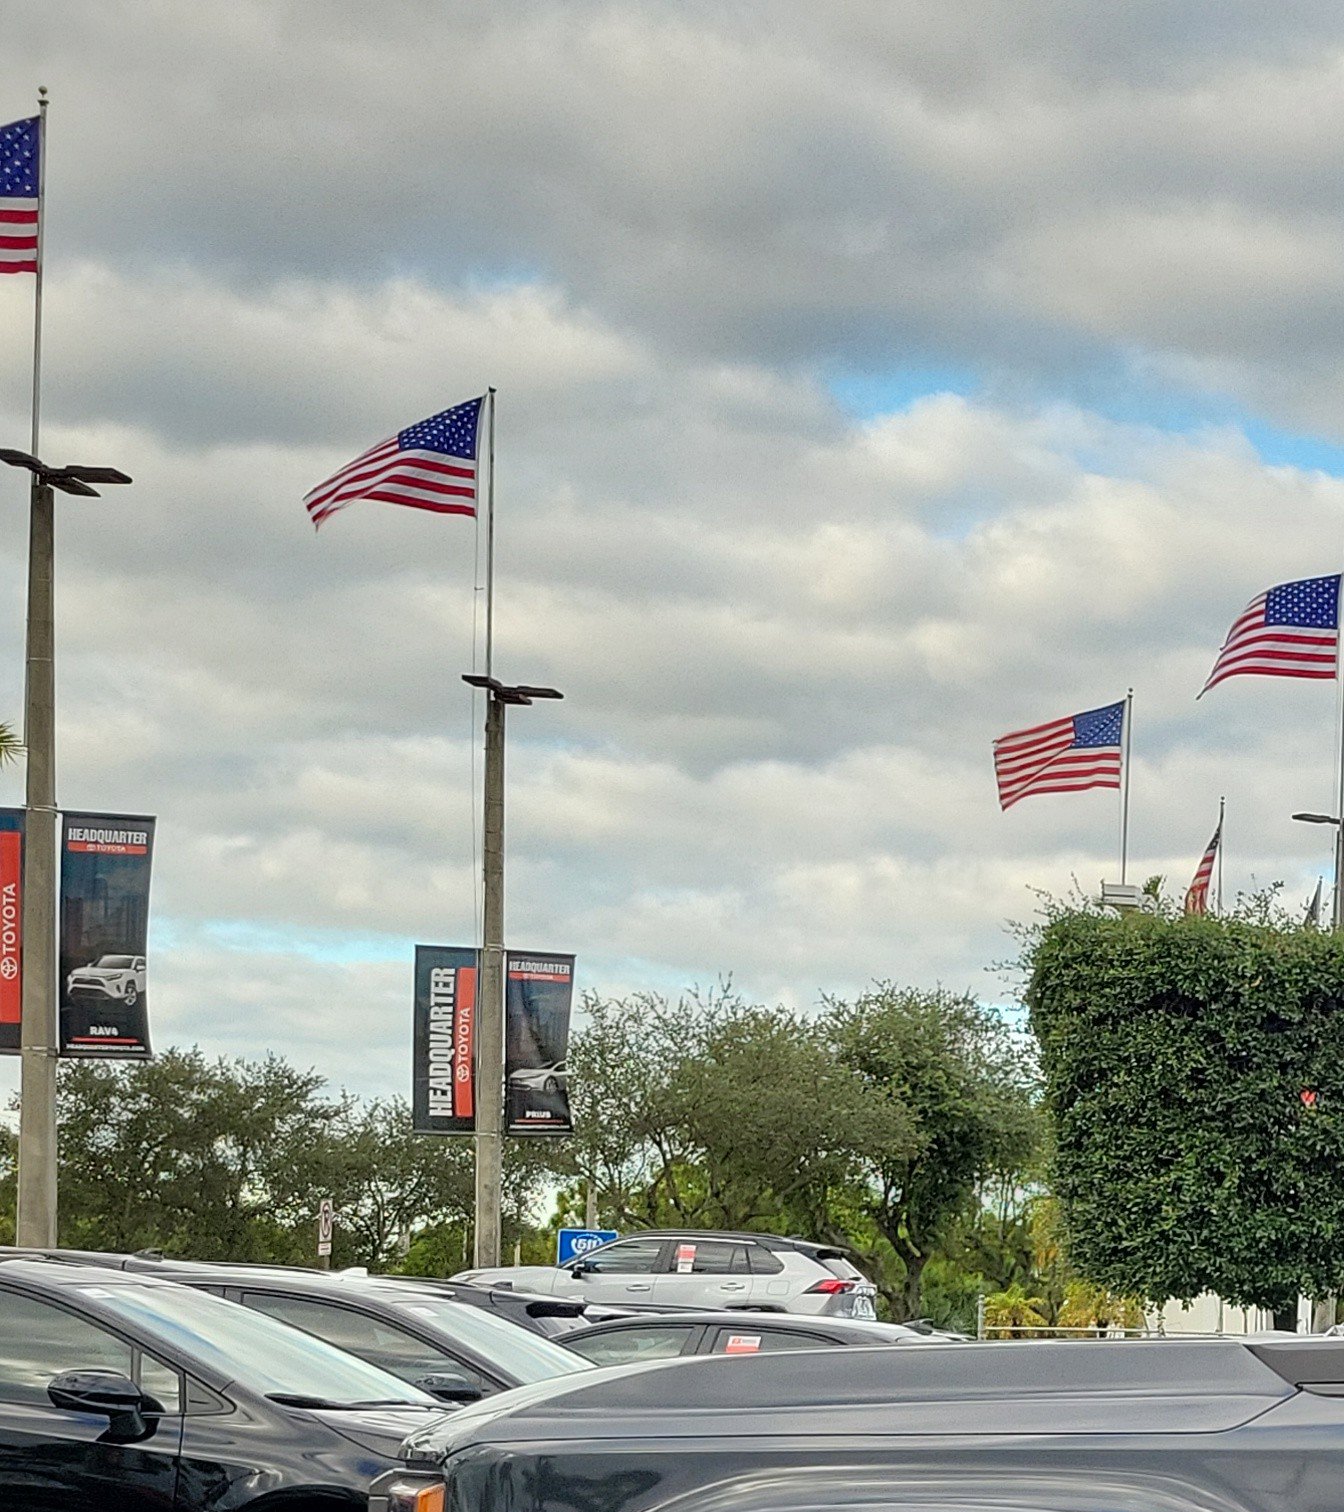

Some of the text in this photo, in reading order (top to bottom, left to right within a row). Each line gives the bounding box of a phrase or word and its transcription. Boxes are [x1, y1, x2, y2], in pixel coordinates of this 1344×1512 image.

[68, 828, 147, 844] HEADQUARTER
[96, 844, 126, 852] TOYOTA
[2, 883, 16, 952] TOYOTA
[90, 1025, 118, 1036] RAV4
[429, 968, 455, 1117] HEADQUARTER
[458, 1007, 470, 1062] TOYOTA
